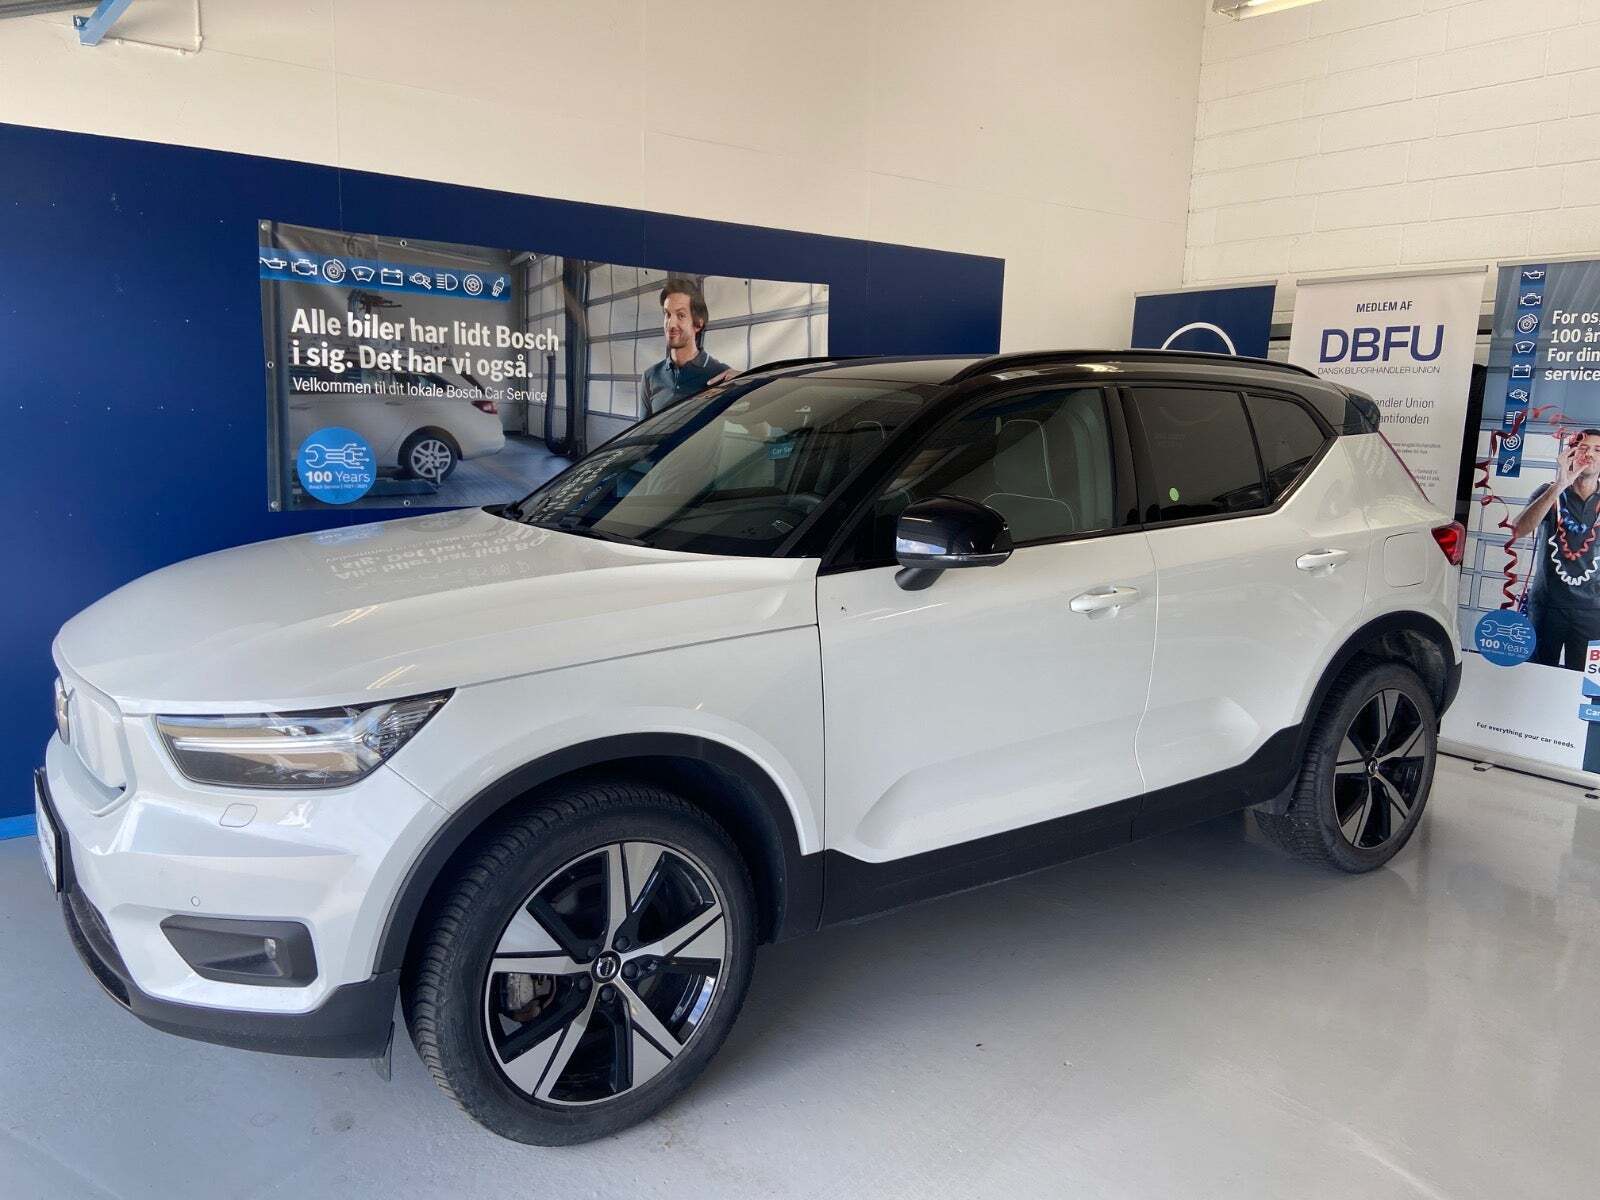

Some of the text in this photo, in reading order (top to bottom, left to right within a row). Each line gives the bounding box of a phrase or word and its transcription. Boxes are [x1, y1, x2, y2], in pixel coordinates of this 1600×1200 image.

[1356, 300, 1413, 313] MEDLEM AF
[1552, 310, 1578, 325] For
[291, 308, 559, 351] Alle biler har lidt Bosch
[1550, 327, 1600, 344] 100 år
[1319, 324, 1445, 363] DBFU
[292, 339, 534, 382] i sig. Det har vi også.
[1547, 347, 1600, 362] For din
[1317, 364, 1441, 375] DANSK BILFORHANDLER UNION
[1544, 366, 1600, 381] service
[293, 377, 547, 402] Velkommen til dit lokale Bosch Car Service
[1405, 396, 1434, 409] Union
[305, 470, 371, 483] 100 Years
[1480, 638, 1500, 649] 100
[1502, 641, 1529, 655] Years
[1477, 721, 1576, 750] For everything your car needs.
